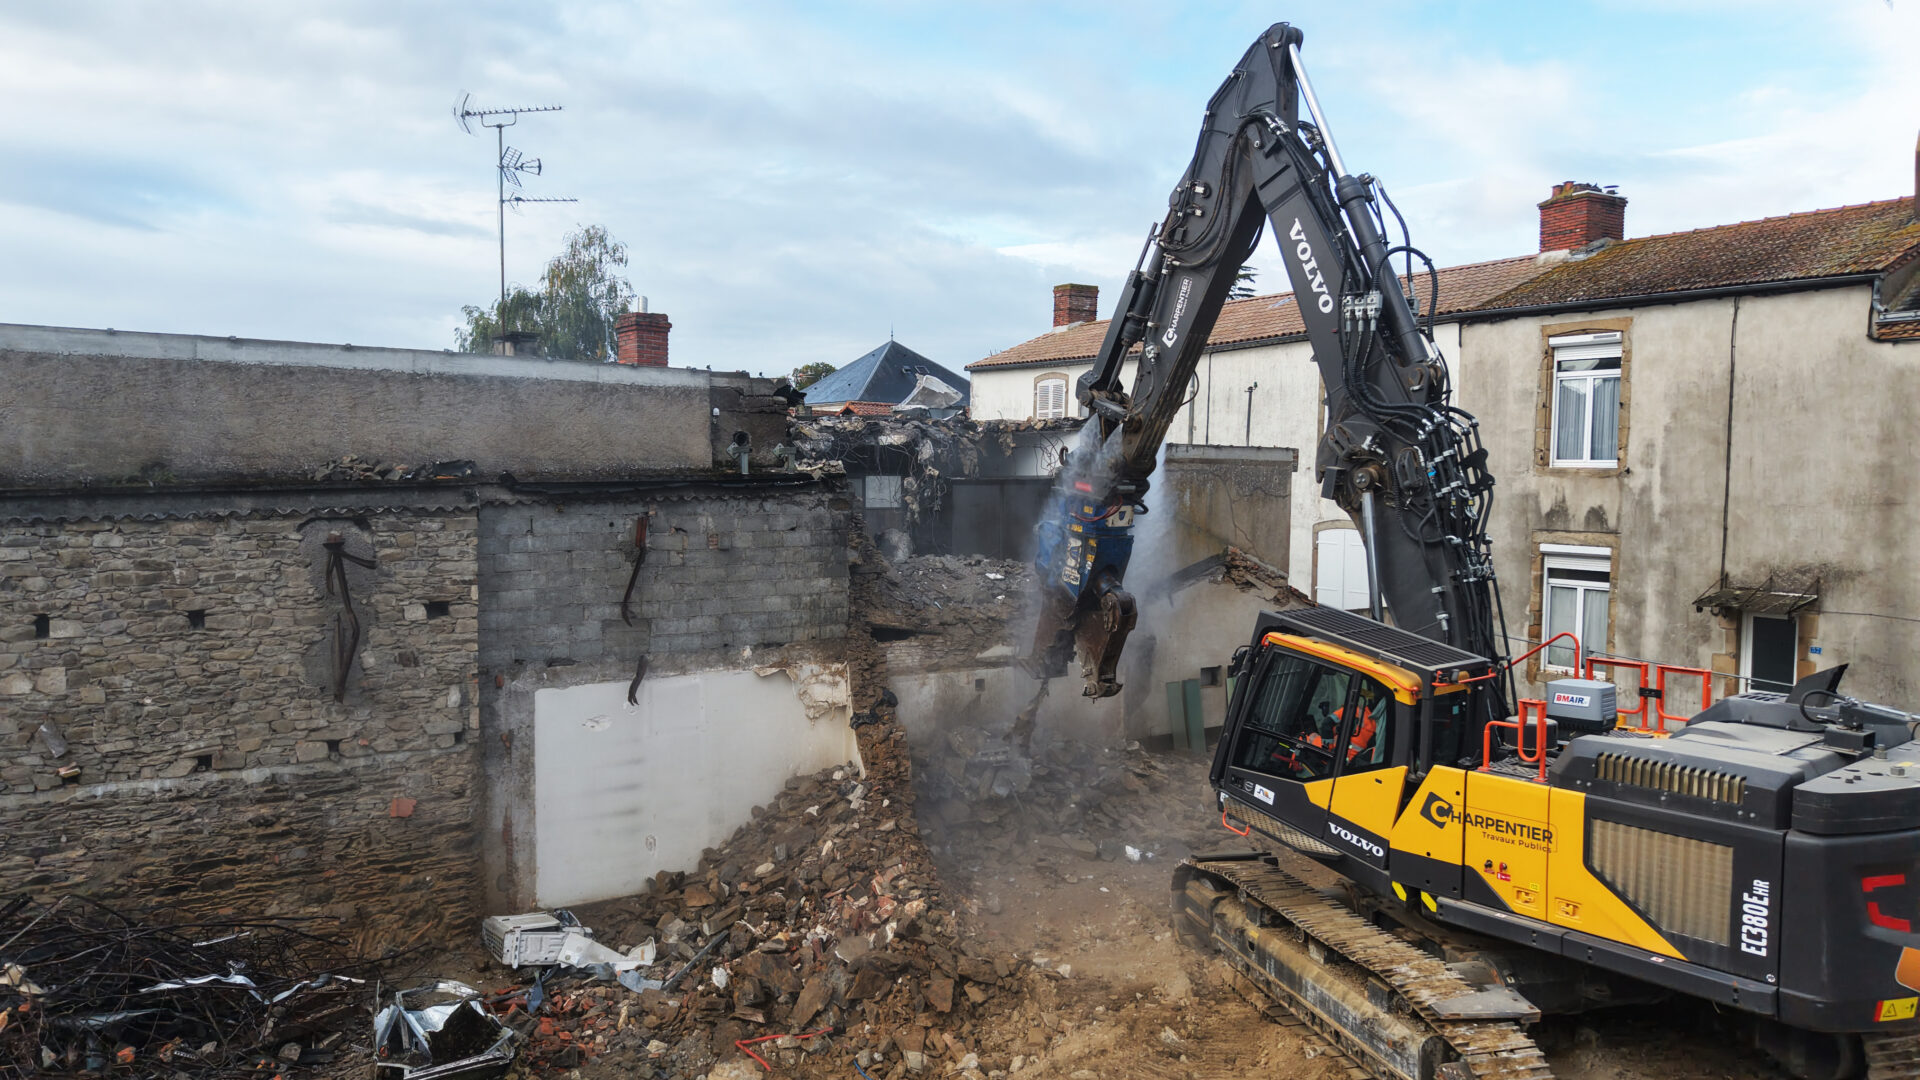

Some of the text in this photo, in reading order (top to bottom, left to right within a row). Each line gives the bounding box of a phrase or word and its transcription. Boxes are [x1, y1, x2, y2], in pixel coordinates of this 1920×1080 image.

[1289, 217, 1334, 314] VOLVO
[1165, 278, 1190, 342] CHARPENTIER
[1556, 694, 1584, 705] BMAIR
[1328, 821, 1384, 857] VOLVO
[1428, 799, 1553, 844] CHARPENTIER
[1482, 831, 1552, 854] Travaux Publics
